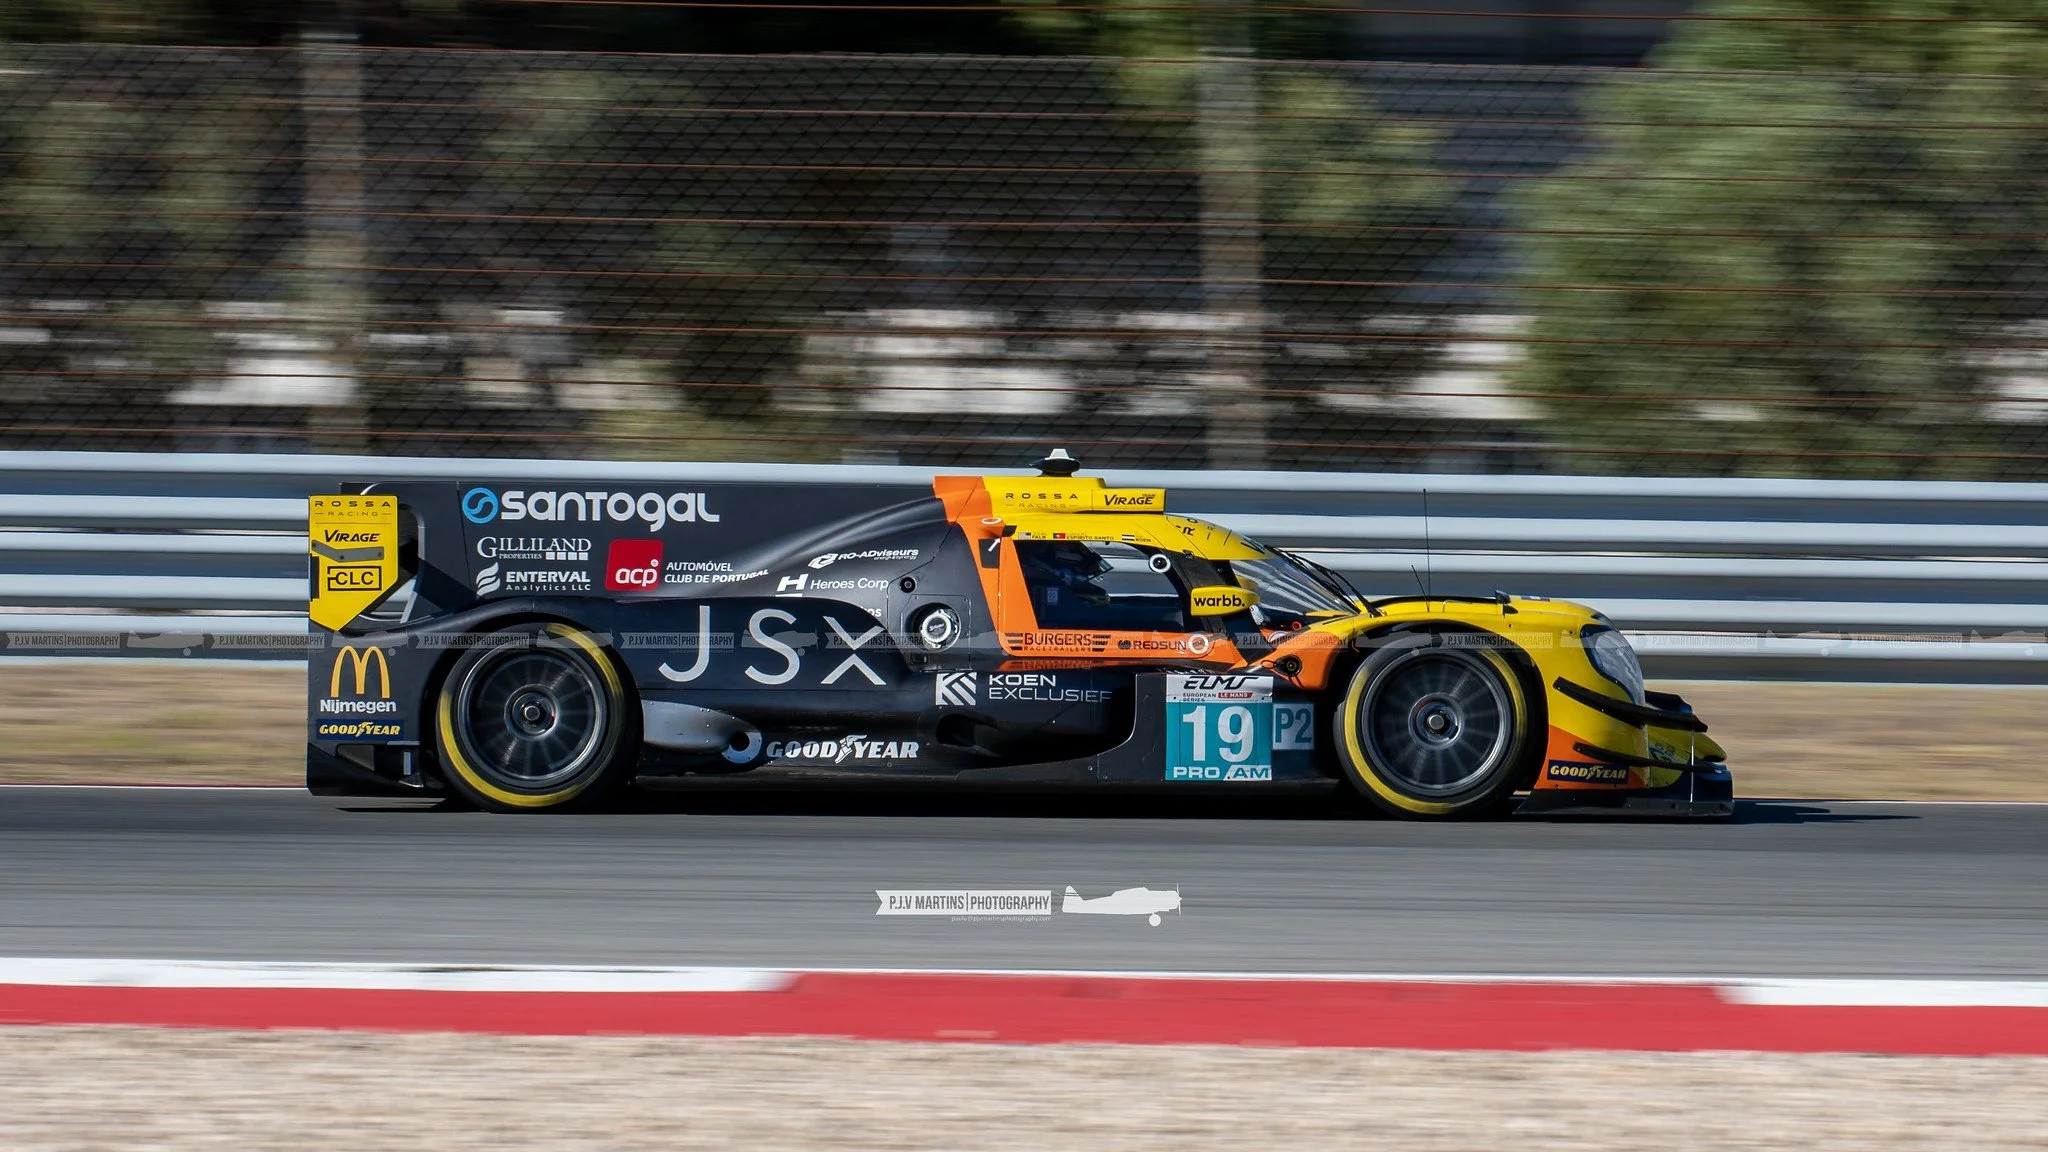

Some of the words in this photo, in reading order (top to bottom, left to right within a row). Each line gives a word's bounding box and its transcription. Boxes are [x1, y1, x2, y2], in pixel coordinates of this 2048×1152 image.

[1104, 495, 1154, 506] VIRAGE
[324, 530, 380, 542] VIRAGE
[477, 536, 592, 558] GILLILAND
[666, 560, 734, 572] AUTOMÓVEL
[336, 572, 374, 585] CLC
[506, 572, 590, 582] ENTERVAL
[615, 566, 658, 587] acp
[664, 574, 692, 584] CLUB
[694, 574, 709, 583] DE
[712, 569, 769, 583] PORTUGAL
[506, 584, 568, 592] Analytics
[810, 579, 854, 590] Heroes
[858, 578, 889, 590] Corp
[1194, 594, 1246, 606] warbb.
[1024, 632, 1092, 646] BURGERS
[1134, 640, 1187, 650] REDSUN
[989, 674, 1056, 687] KOEN
[1183, 676, 1259, 690] ELMS
[988, 687, 1112, 703] EXCLUSIEF
[320, 700, 397, 714] Nijmegen
[319, 722, 400, 737] GOODYEAR
[1275, 708, 1312, 744] P2
[1182, 706, 1254, 762] 19
[766, 734, 920, 764] GOODYEAR
[1174, 766, 1220, 779] PRO
[1232, 767, 1269, 779] AM
[1550, 764, 1627, 781] GOODYEAR
